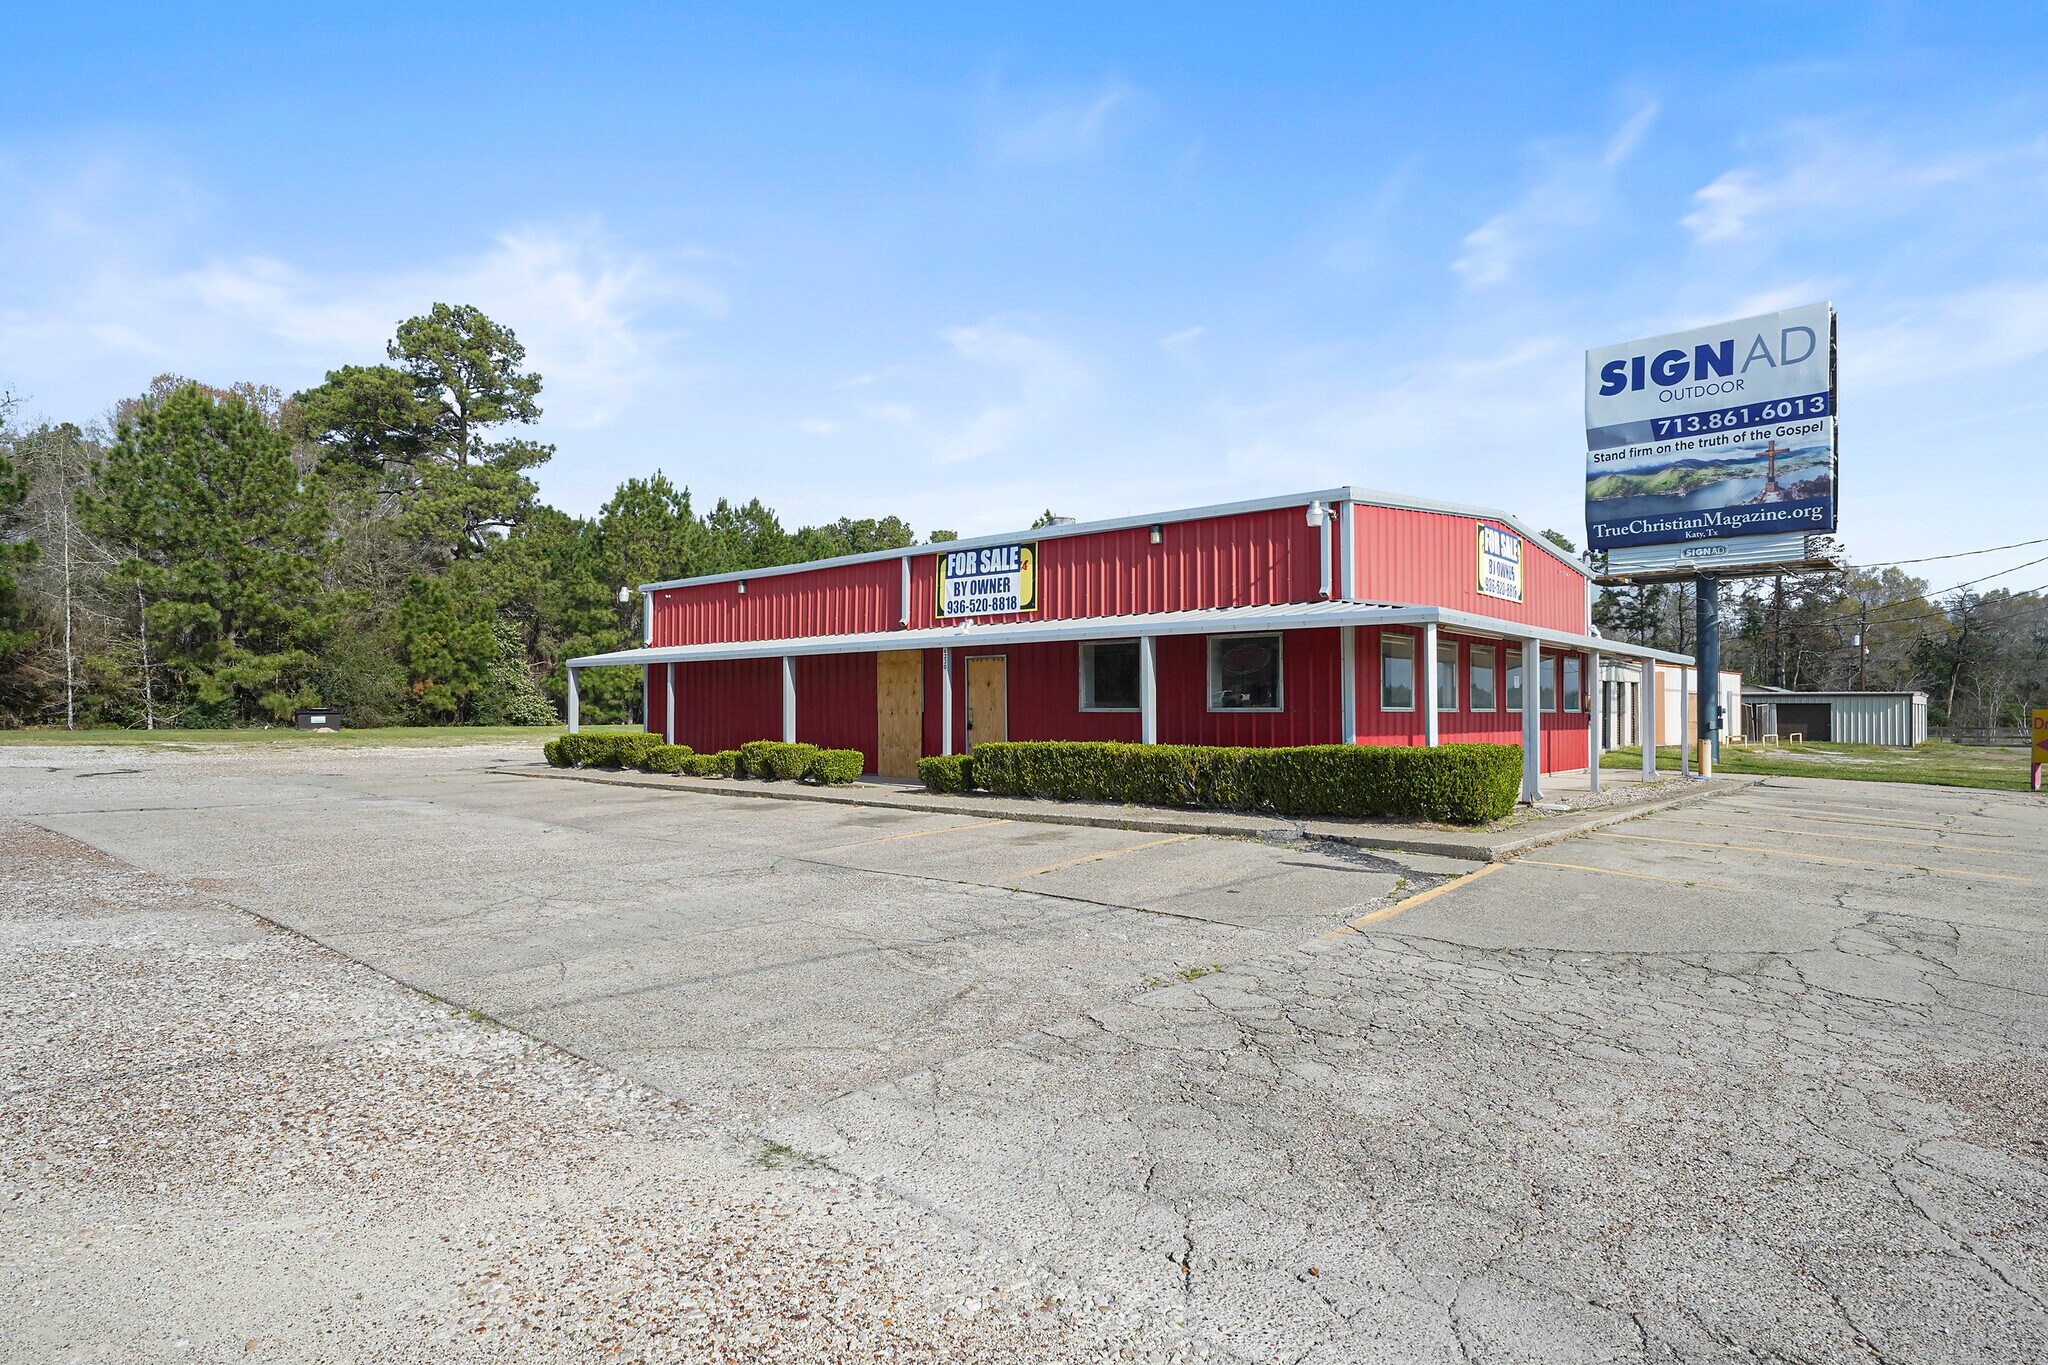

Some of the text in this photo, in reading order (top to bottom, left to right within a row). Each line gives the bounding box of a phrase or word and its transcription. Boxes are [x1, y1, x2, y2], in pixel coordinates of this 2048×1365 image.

[1659, 379, 1745, 403] OUTDOOR
[1658, 397, 1825, 436] 713.861.6013
[1593, 420, 1824, 463] Stand firm on the truth of the Gospel
[1593, 506, 1824, 538] TrueChristianMagazine.org
[1685, 528, 1719, 539] Katy, Tx
[947, 551, 977, 576] FOR
[980, 546, 1019, 573] SALE
[953, 577, 1011, 597] BY OWNER
[947, 595, 1017, 614] 936-520-8818
